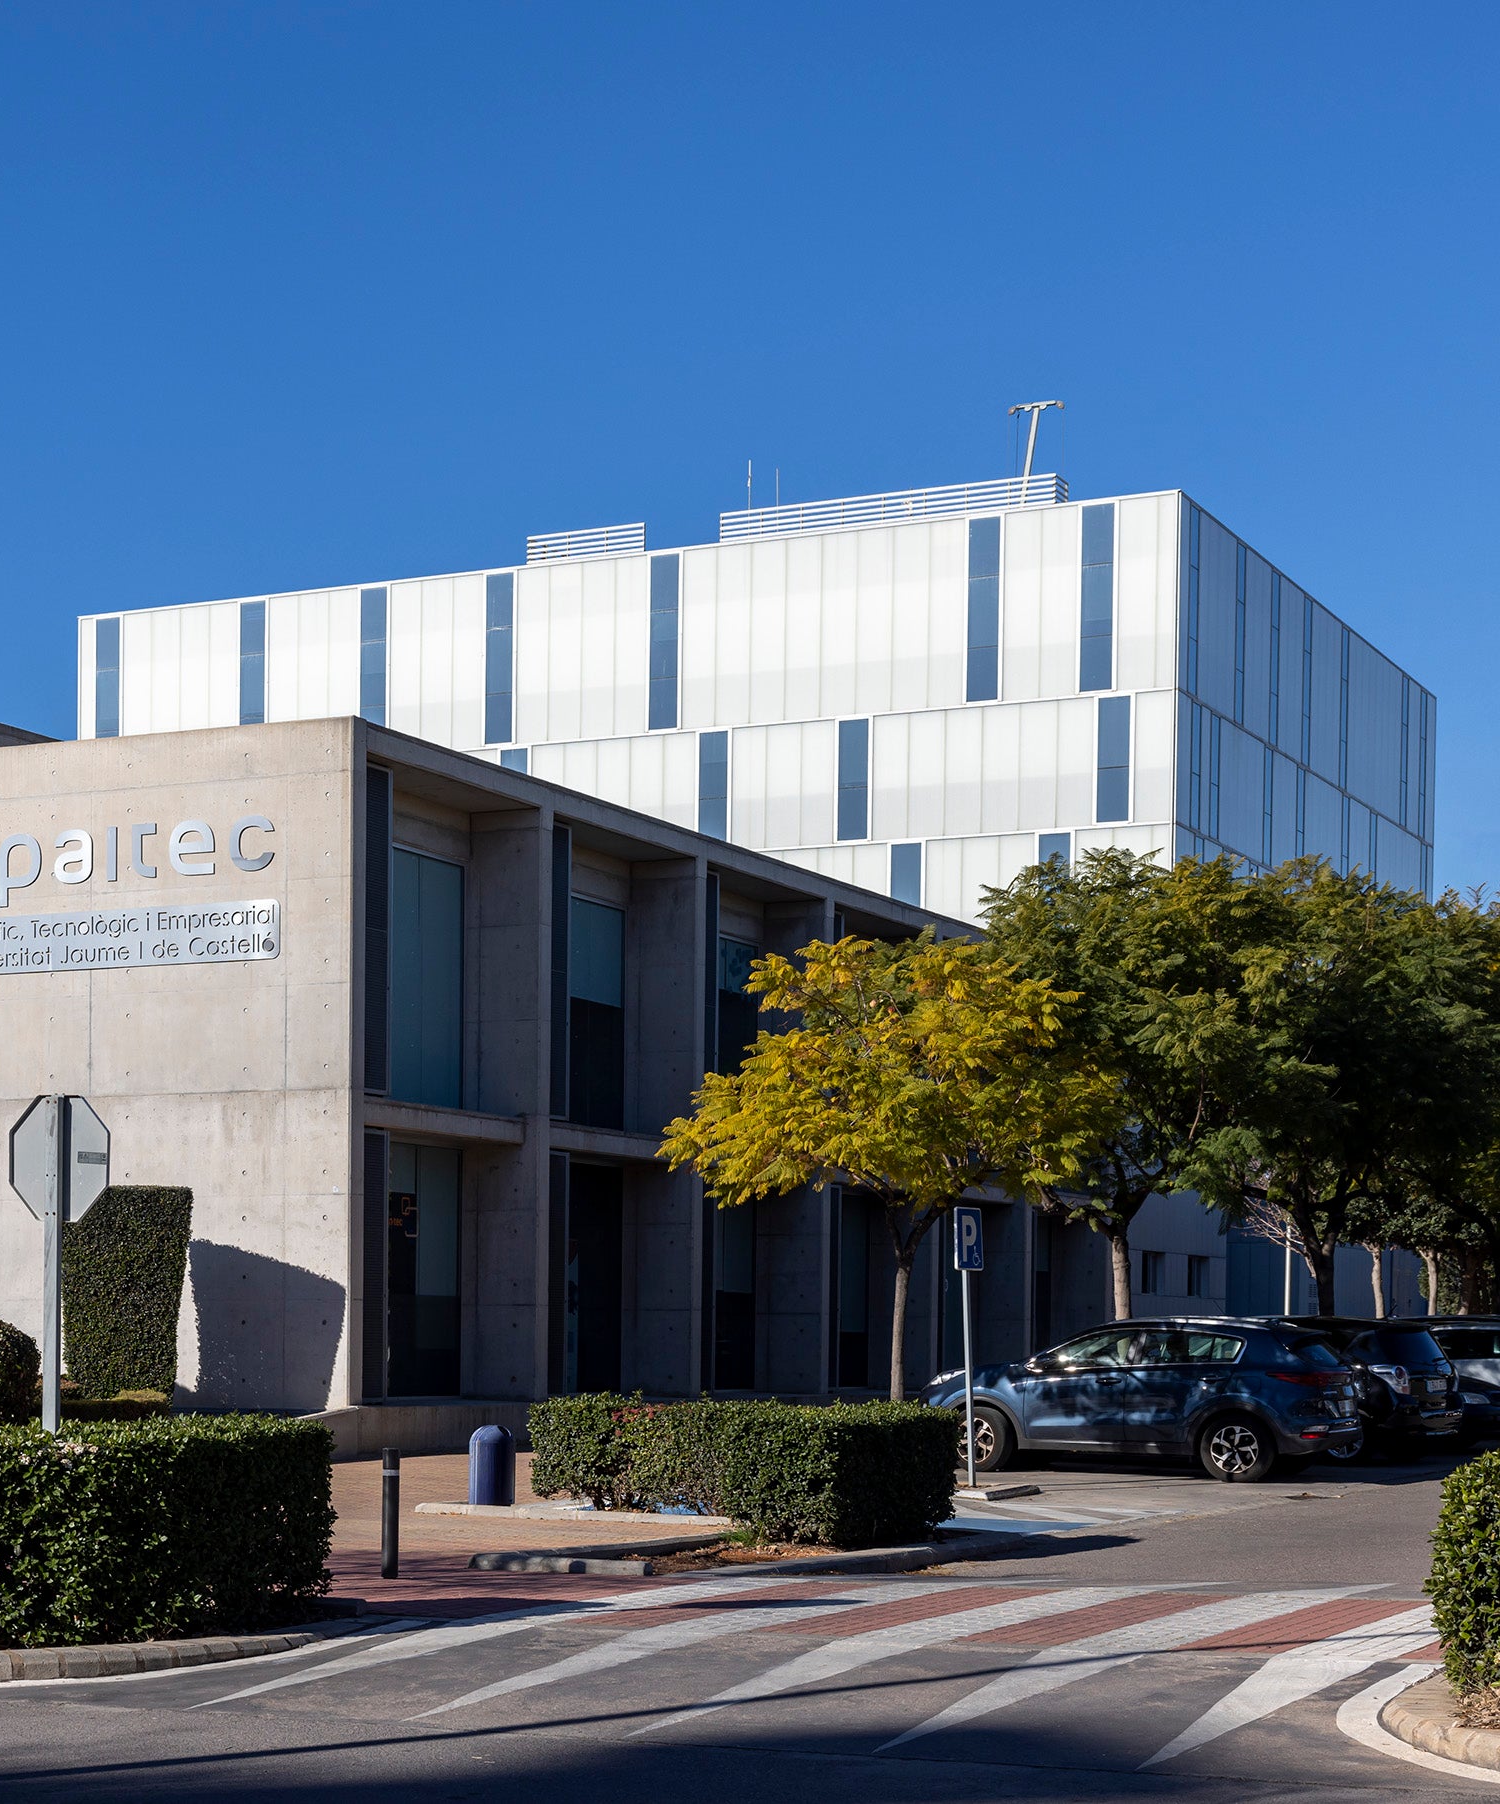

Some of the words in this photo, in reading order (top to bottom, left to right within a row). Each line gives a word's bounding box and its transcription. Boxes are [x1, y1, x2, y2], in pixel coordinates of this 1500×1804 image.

[31, 914, 139, 939] Tecnològic
[157, 904, 275, 933] Empresarial
[60, 945, 130, 964] Jaume
[152, 939, 179, 959] de
[189, 931, 275, 957] Castelló
[961, 1215, 977, 1262] P
